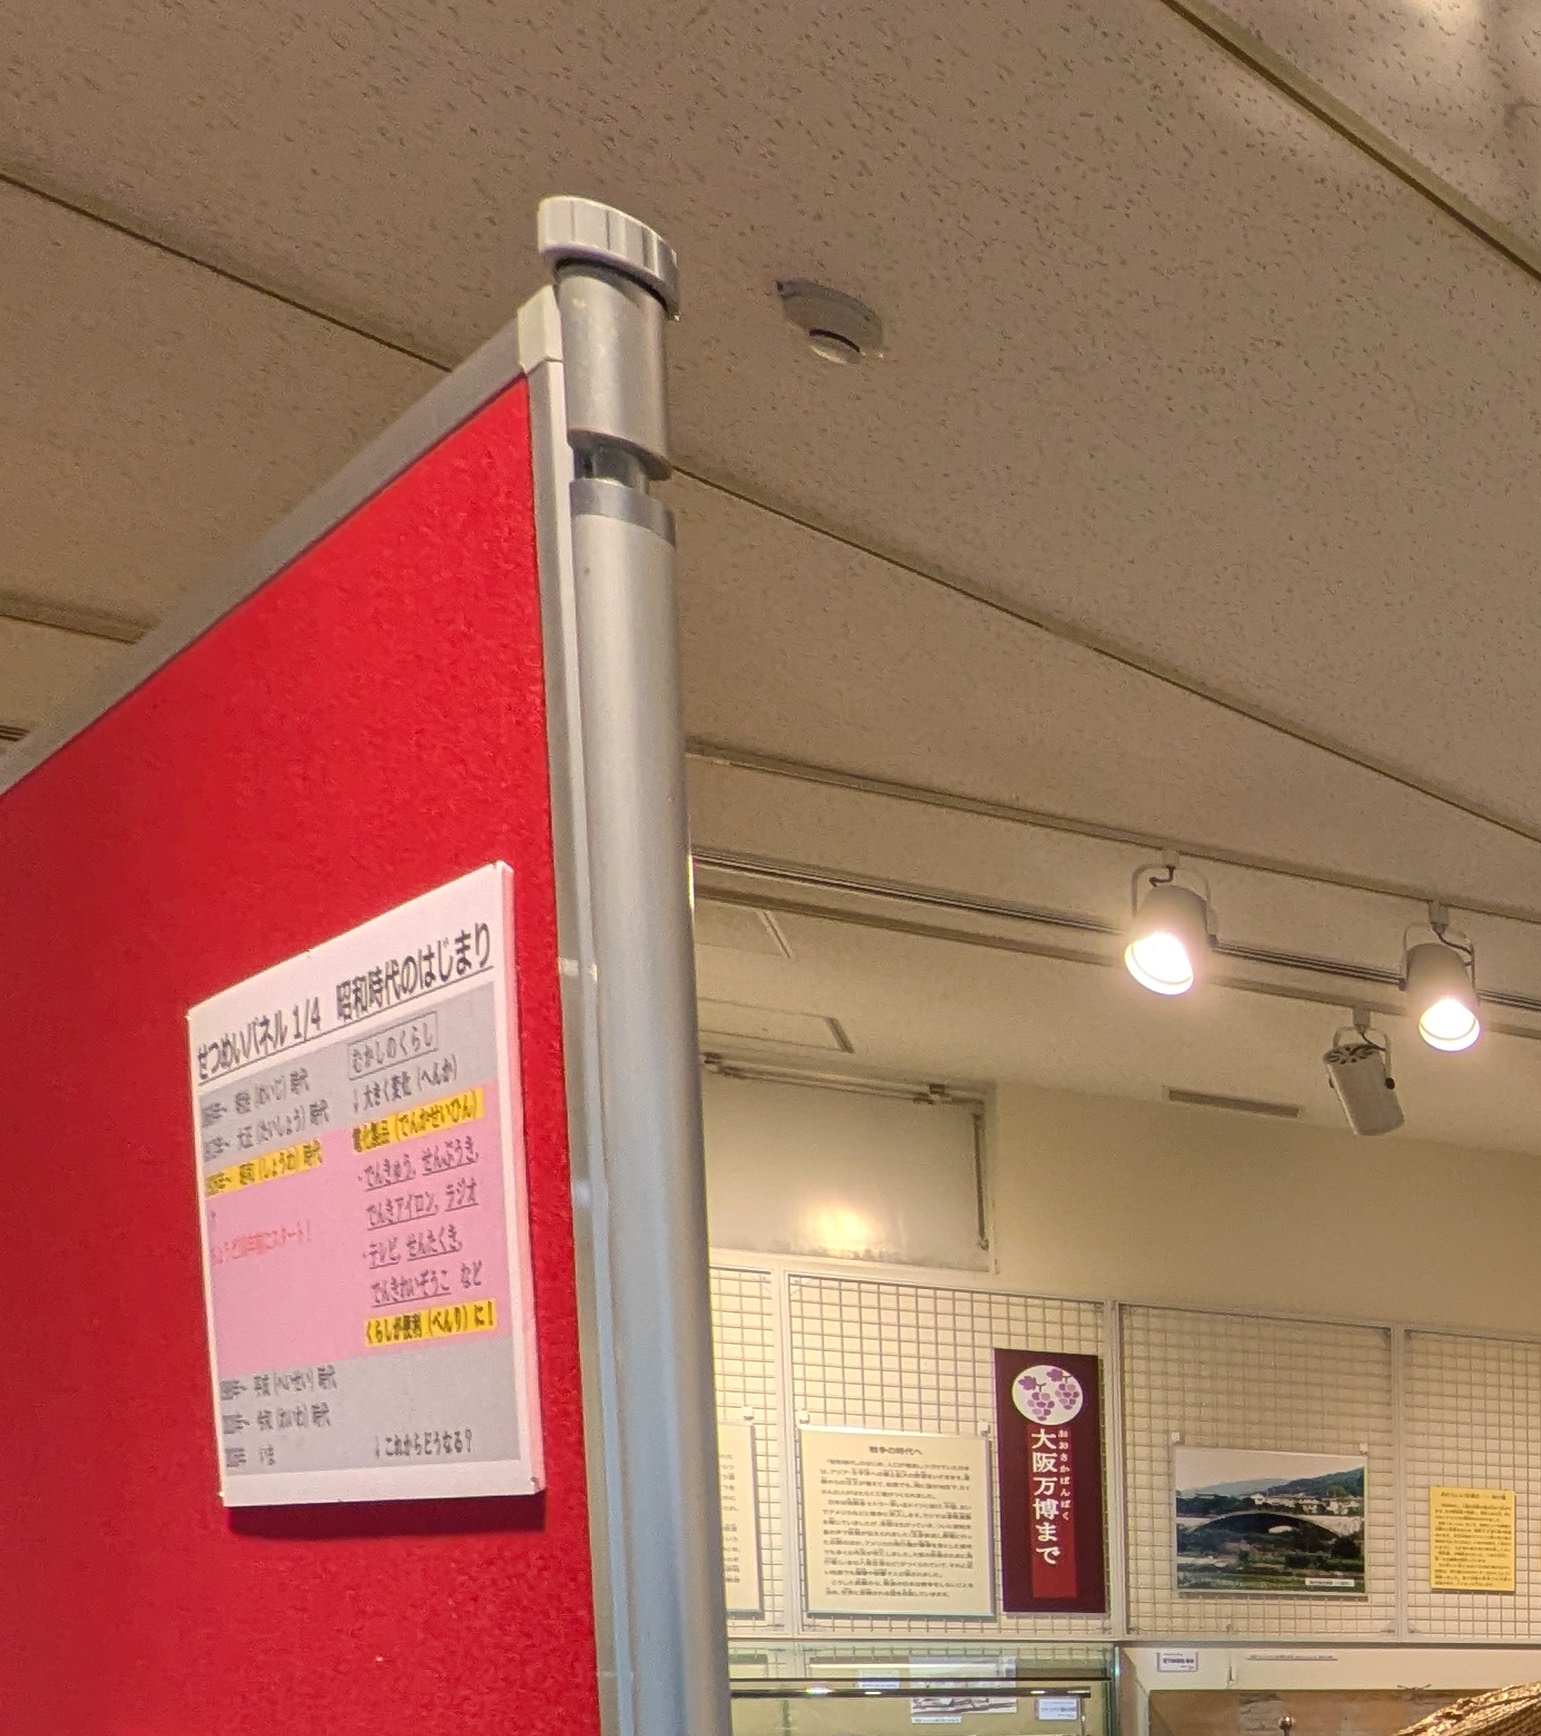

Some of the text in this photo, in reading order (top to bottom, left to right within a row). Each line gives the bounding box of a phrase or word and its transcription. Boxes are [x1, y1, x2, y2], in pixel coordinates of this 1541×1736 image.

[335, 918, 491, 1024] 昭和時代のはじまり
[1031, 1428, 1061, 1565] 大阪万博まで
